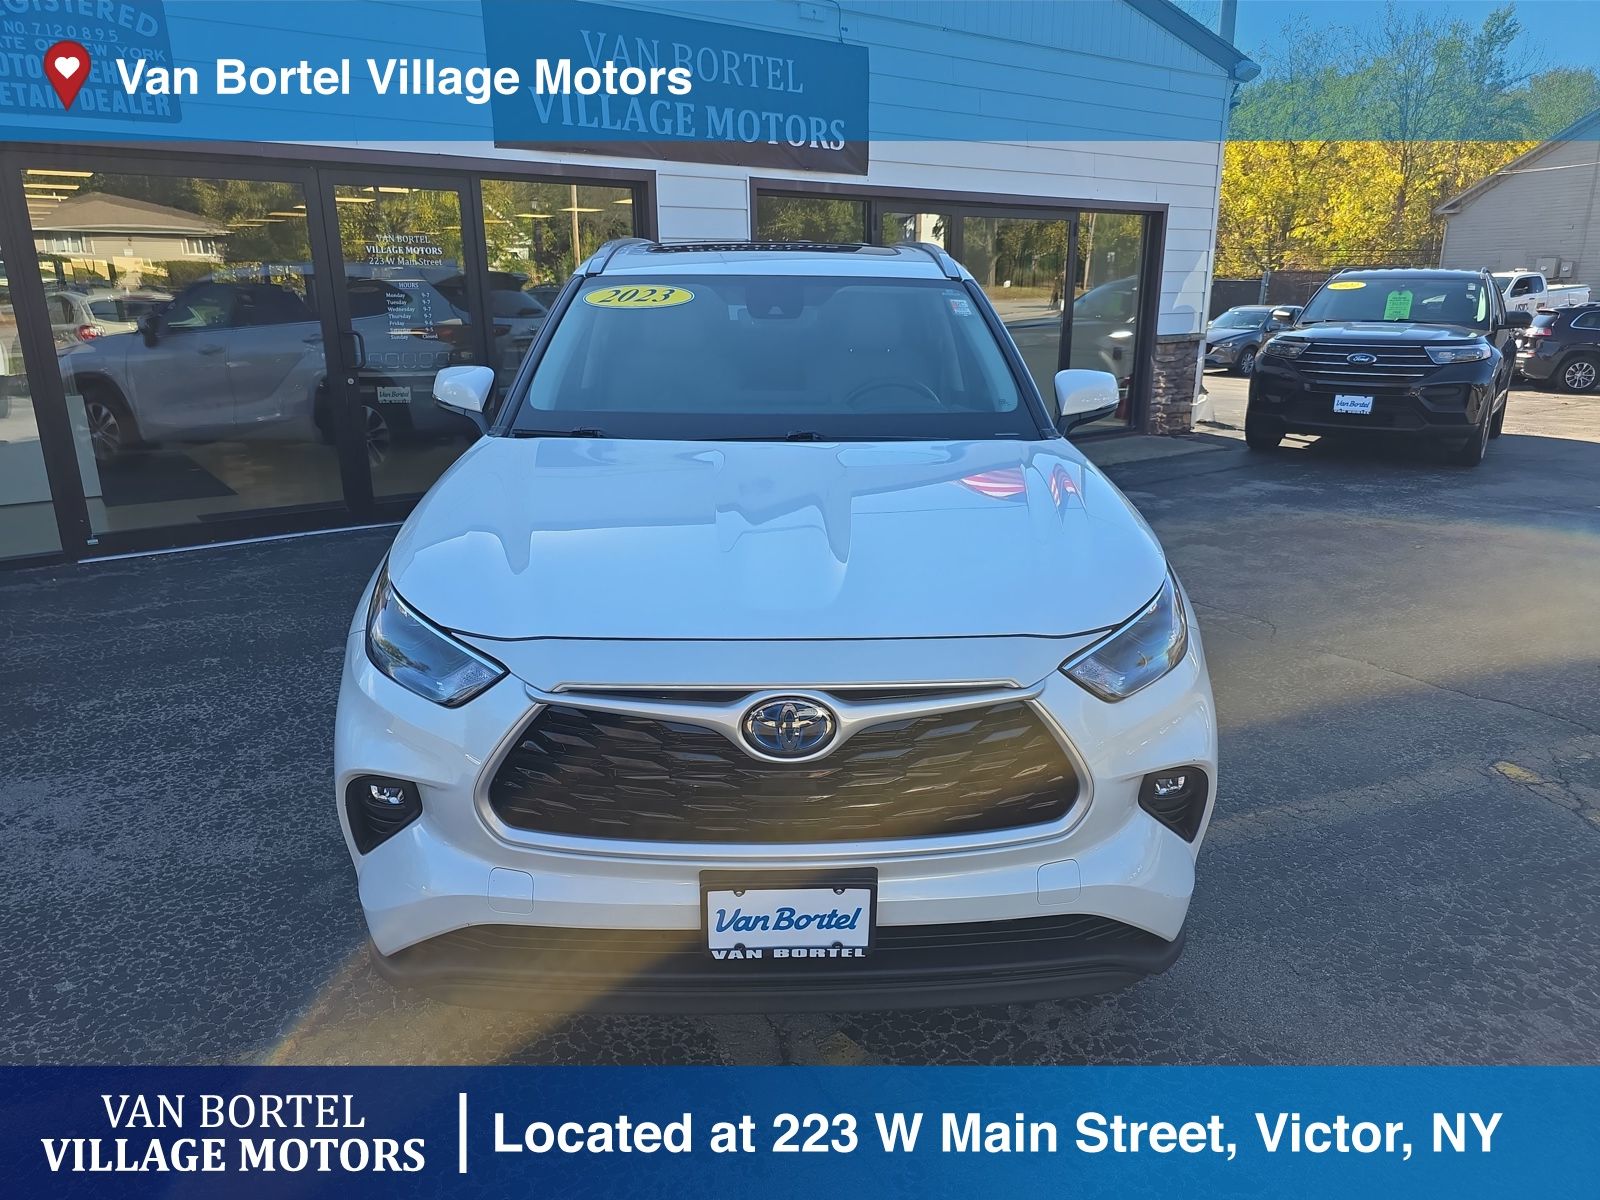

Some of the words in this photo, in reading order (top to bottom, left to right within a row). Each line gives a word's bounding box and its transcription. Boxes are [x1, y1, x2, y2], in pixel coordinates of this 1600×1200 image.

[0, 0, 158, 37] GISTERED
[3, 20, 28, 35] NO.
[31, 22, 119, 42] 7120895
[115, 45, 166, 61] YORK
[580, 29, 660, 73] VAN
[672, 42, 804, 93] BORTEL
[79, 88, 171, 116] DEALER
[528, 86, 695, 138] VILLAGE
[705, 105, 845, 151] MOTORS
[376, 234, 396, 243] VAN
[398, 235, 431, 244] BORTEL
[365, 246, 404, 254] VILLAGE
[405, 246, 443, 255] MOTORS
[369, 257, 385, 265] 223
[386, 257, 396, 265] W
[397, 257, 417, 265] Main
[419, 257, 443, 266] Street
[598, 289, 676, 303] 2023
[1336, 399, 1349, 407] Van
[1349, 400, 1371, 408] Bortel
[715, 907, 769, 933] Van
[772, 906, 863, 931] Bortel
[711, 949, 763, 960] VAN
[773, 948, 867, 958] BORTEL
